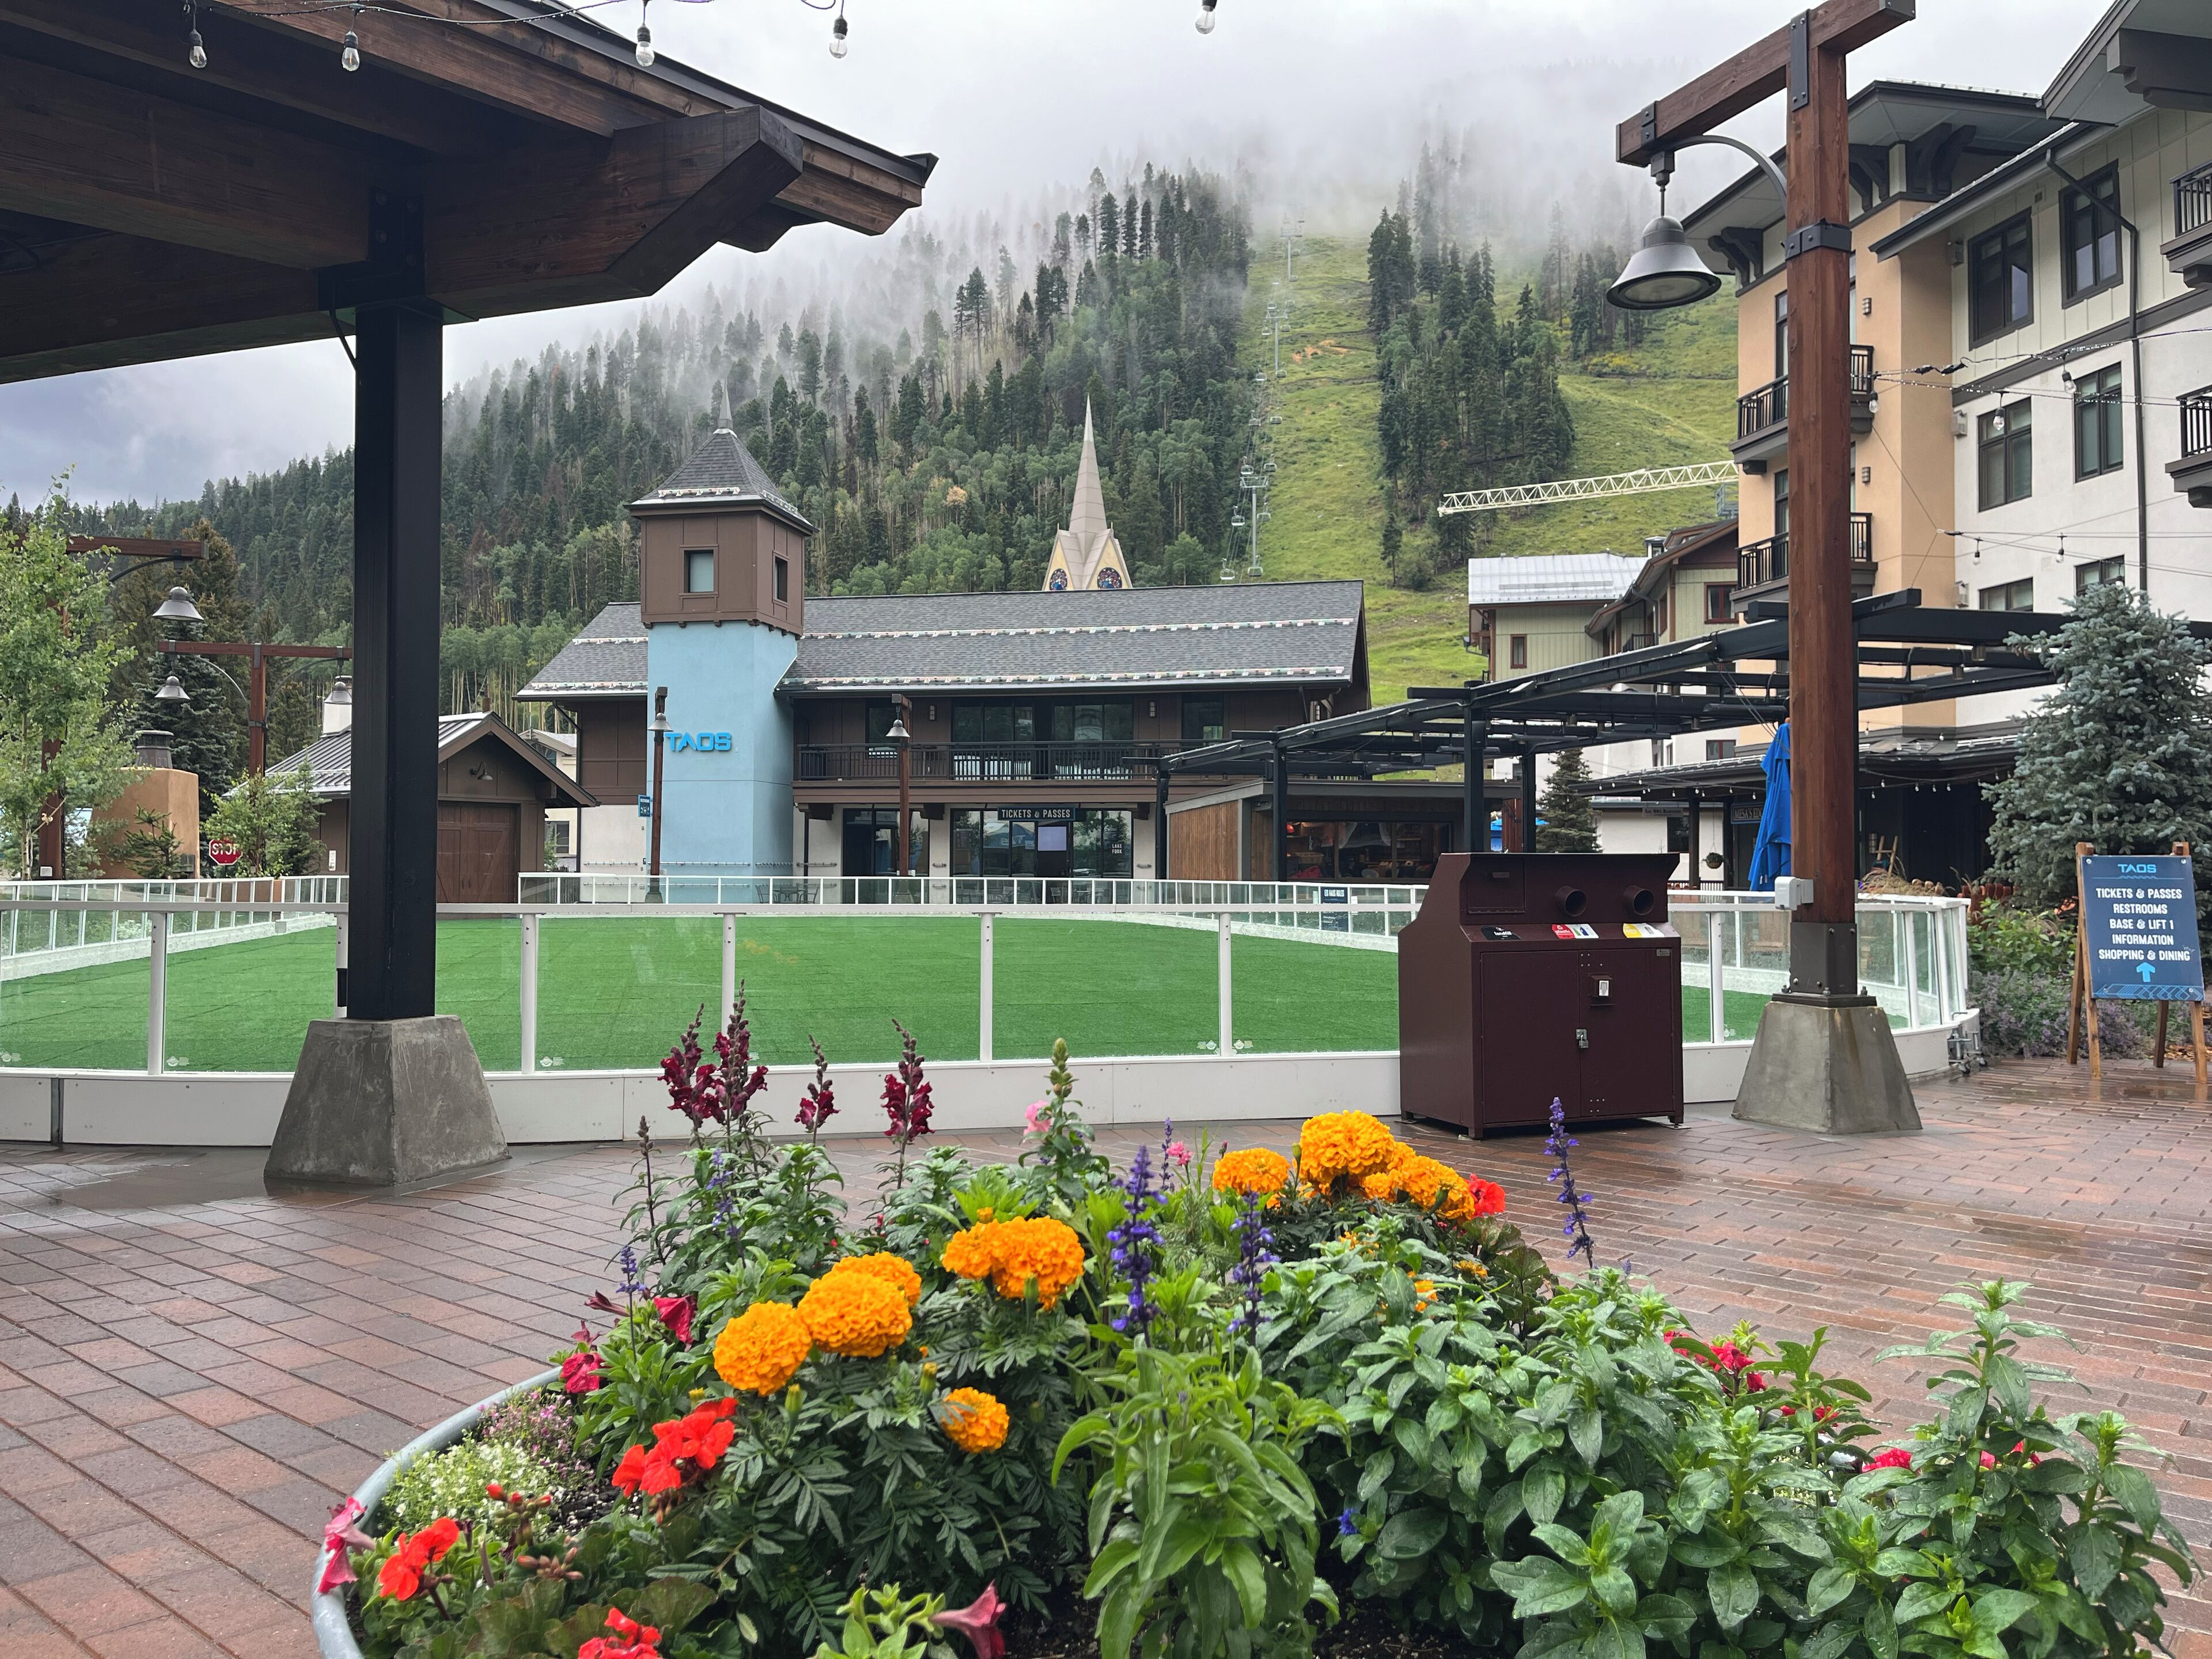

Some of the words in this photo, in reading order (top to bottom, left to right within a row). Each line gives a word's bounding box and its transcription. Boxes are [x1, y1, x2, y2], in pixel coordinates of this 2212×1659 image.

[664, 732, 731, 751] TAOS
[1002, 809, 1032, 818] TICKETS
[1043, 809, 1070, 818] PASSES
[1734, 808, 1752, 819] MESA'S
[2118, 863, 2157, 873] TAOS
[2096, 888, 2133, 899] TICKETS
[2135, 888, 2145, 899] &
[2147, 888, 2182, 899] PASSES
[2113, 903, 2168, 914] RESTROOMS
[2109, 918, 2134, 929] BASE
[2137, 919, 2145, 929] &
[2148, 919, 2166, 930] LIFT
[2169, 919, 2174, 930] 1
[2112, 934, 2174, 945] INFORMATION
[2099, 949, 2145, 960] SHOPPING
[2147, 949, 2156, 960] &
[2159, 950, 2191, 961] DINING
